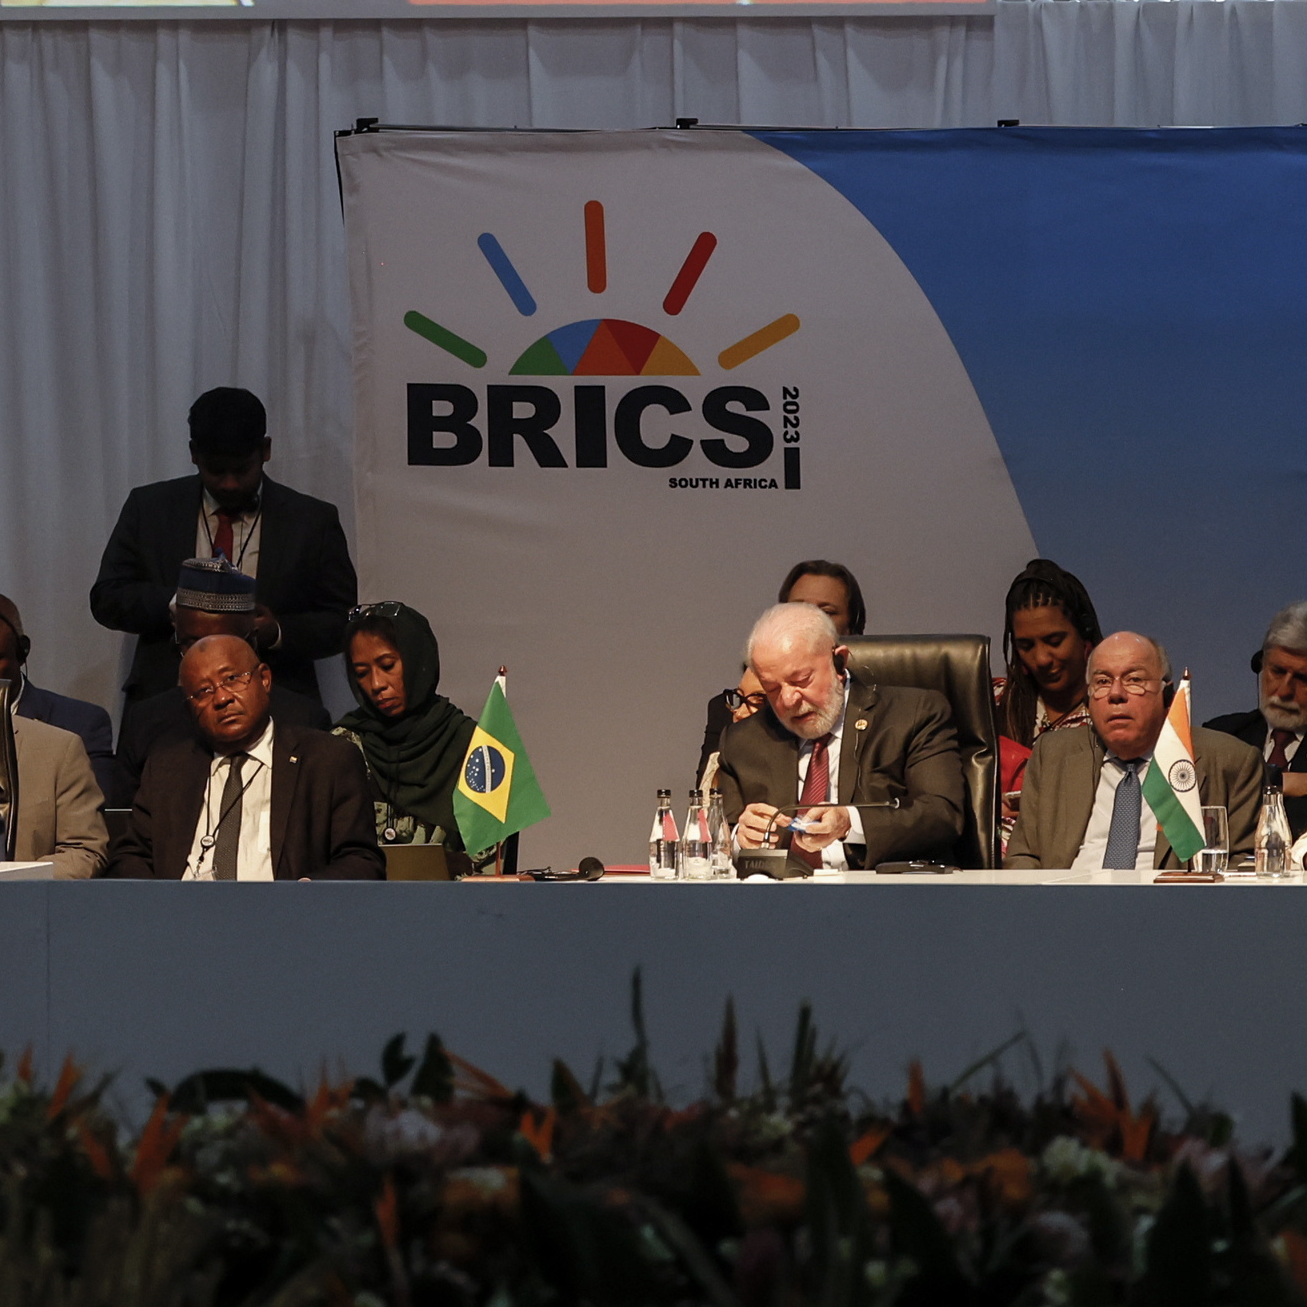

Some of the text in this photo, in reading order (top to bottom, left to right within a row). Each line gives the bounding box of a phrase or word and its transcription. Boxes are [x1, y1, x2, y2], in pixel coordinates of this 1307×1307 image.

[406, 382, 775, 469] BRICS
[782, 385, 801, 444] 2023
[668, 477, 779, 490] SOUTH AFRICA
